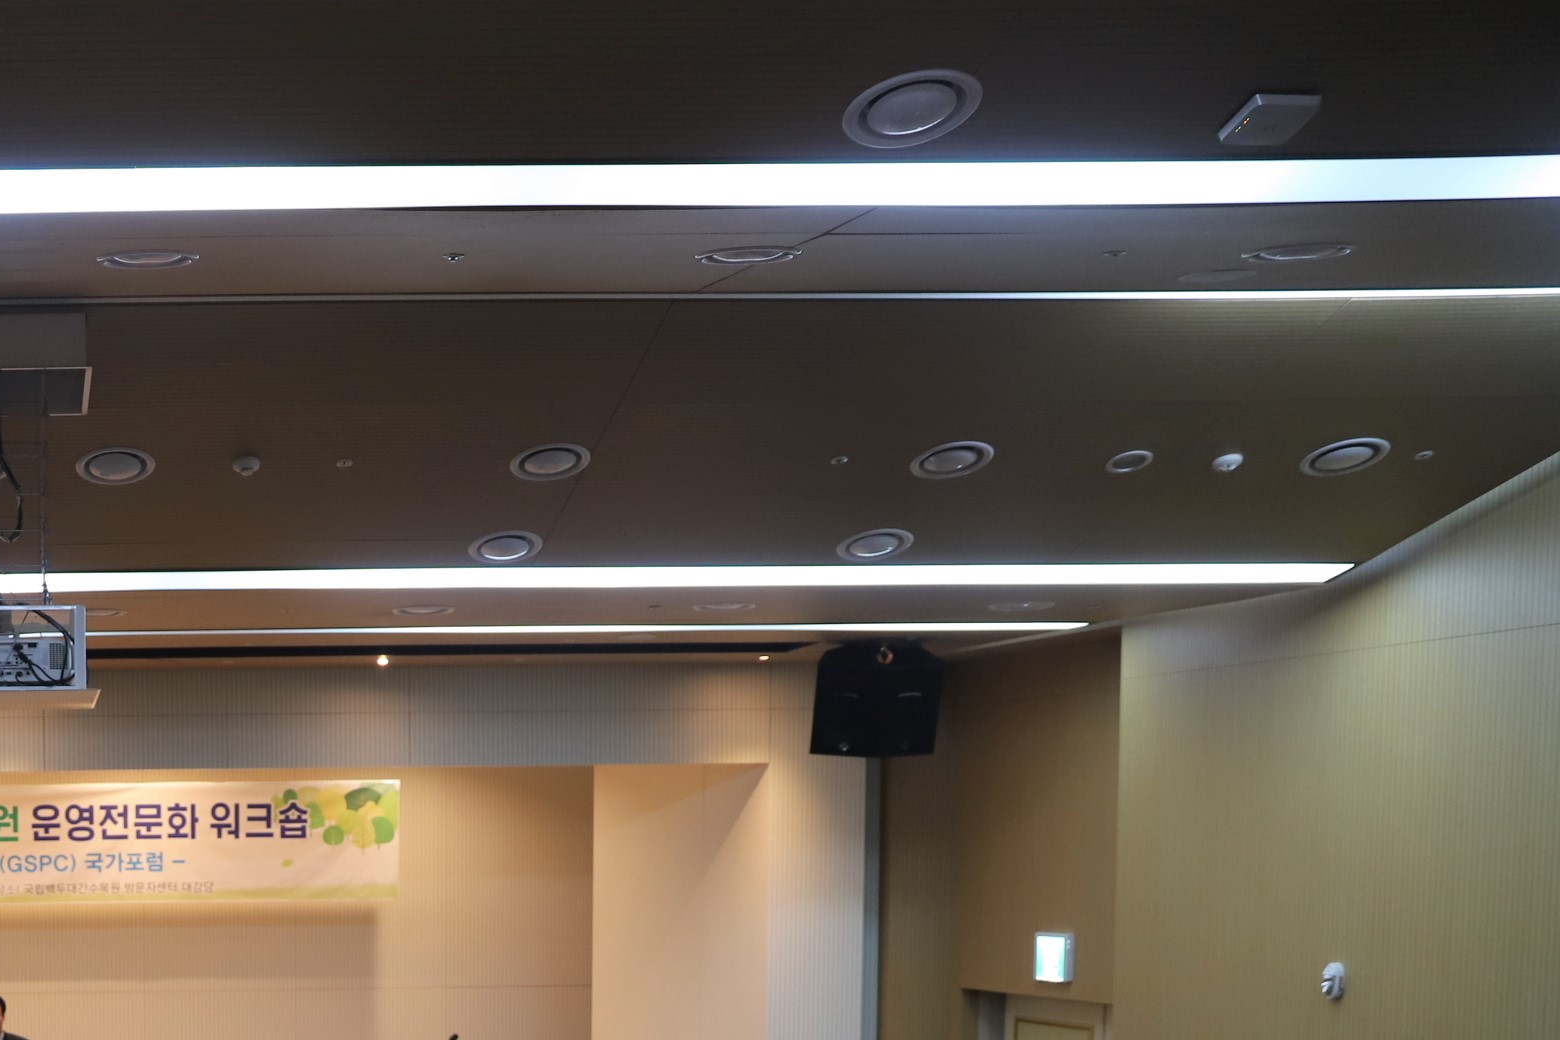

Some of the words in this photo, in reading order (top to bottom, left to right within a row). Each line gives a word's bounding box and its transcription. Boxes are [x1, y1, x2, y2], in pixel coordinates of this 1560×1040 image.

[31, 803, 199, 842] 운영전문화
[210, 802, 308, 840] 워크숍
[84, 851, 164, 874] 국가포럼
